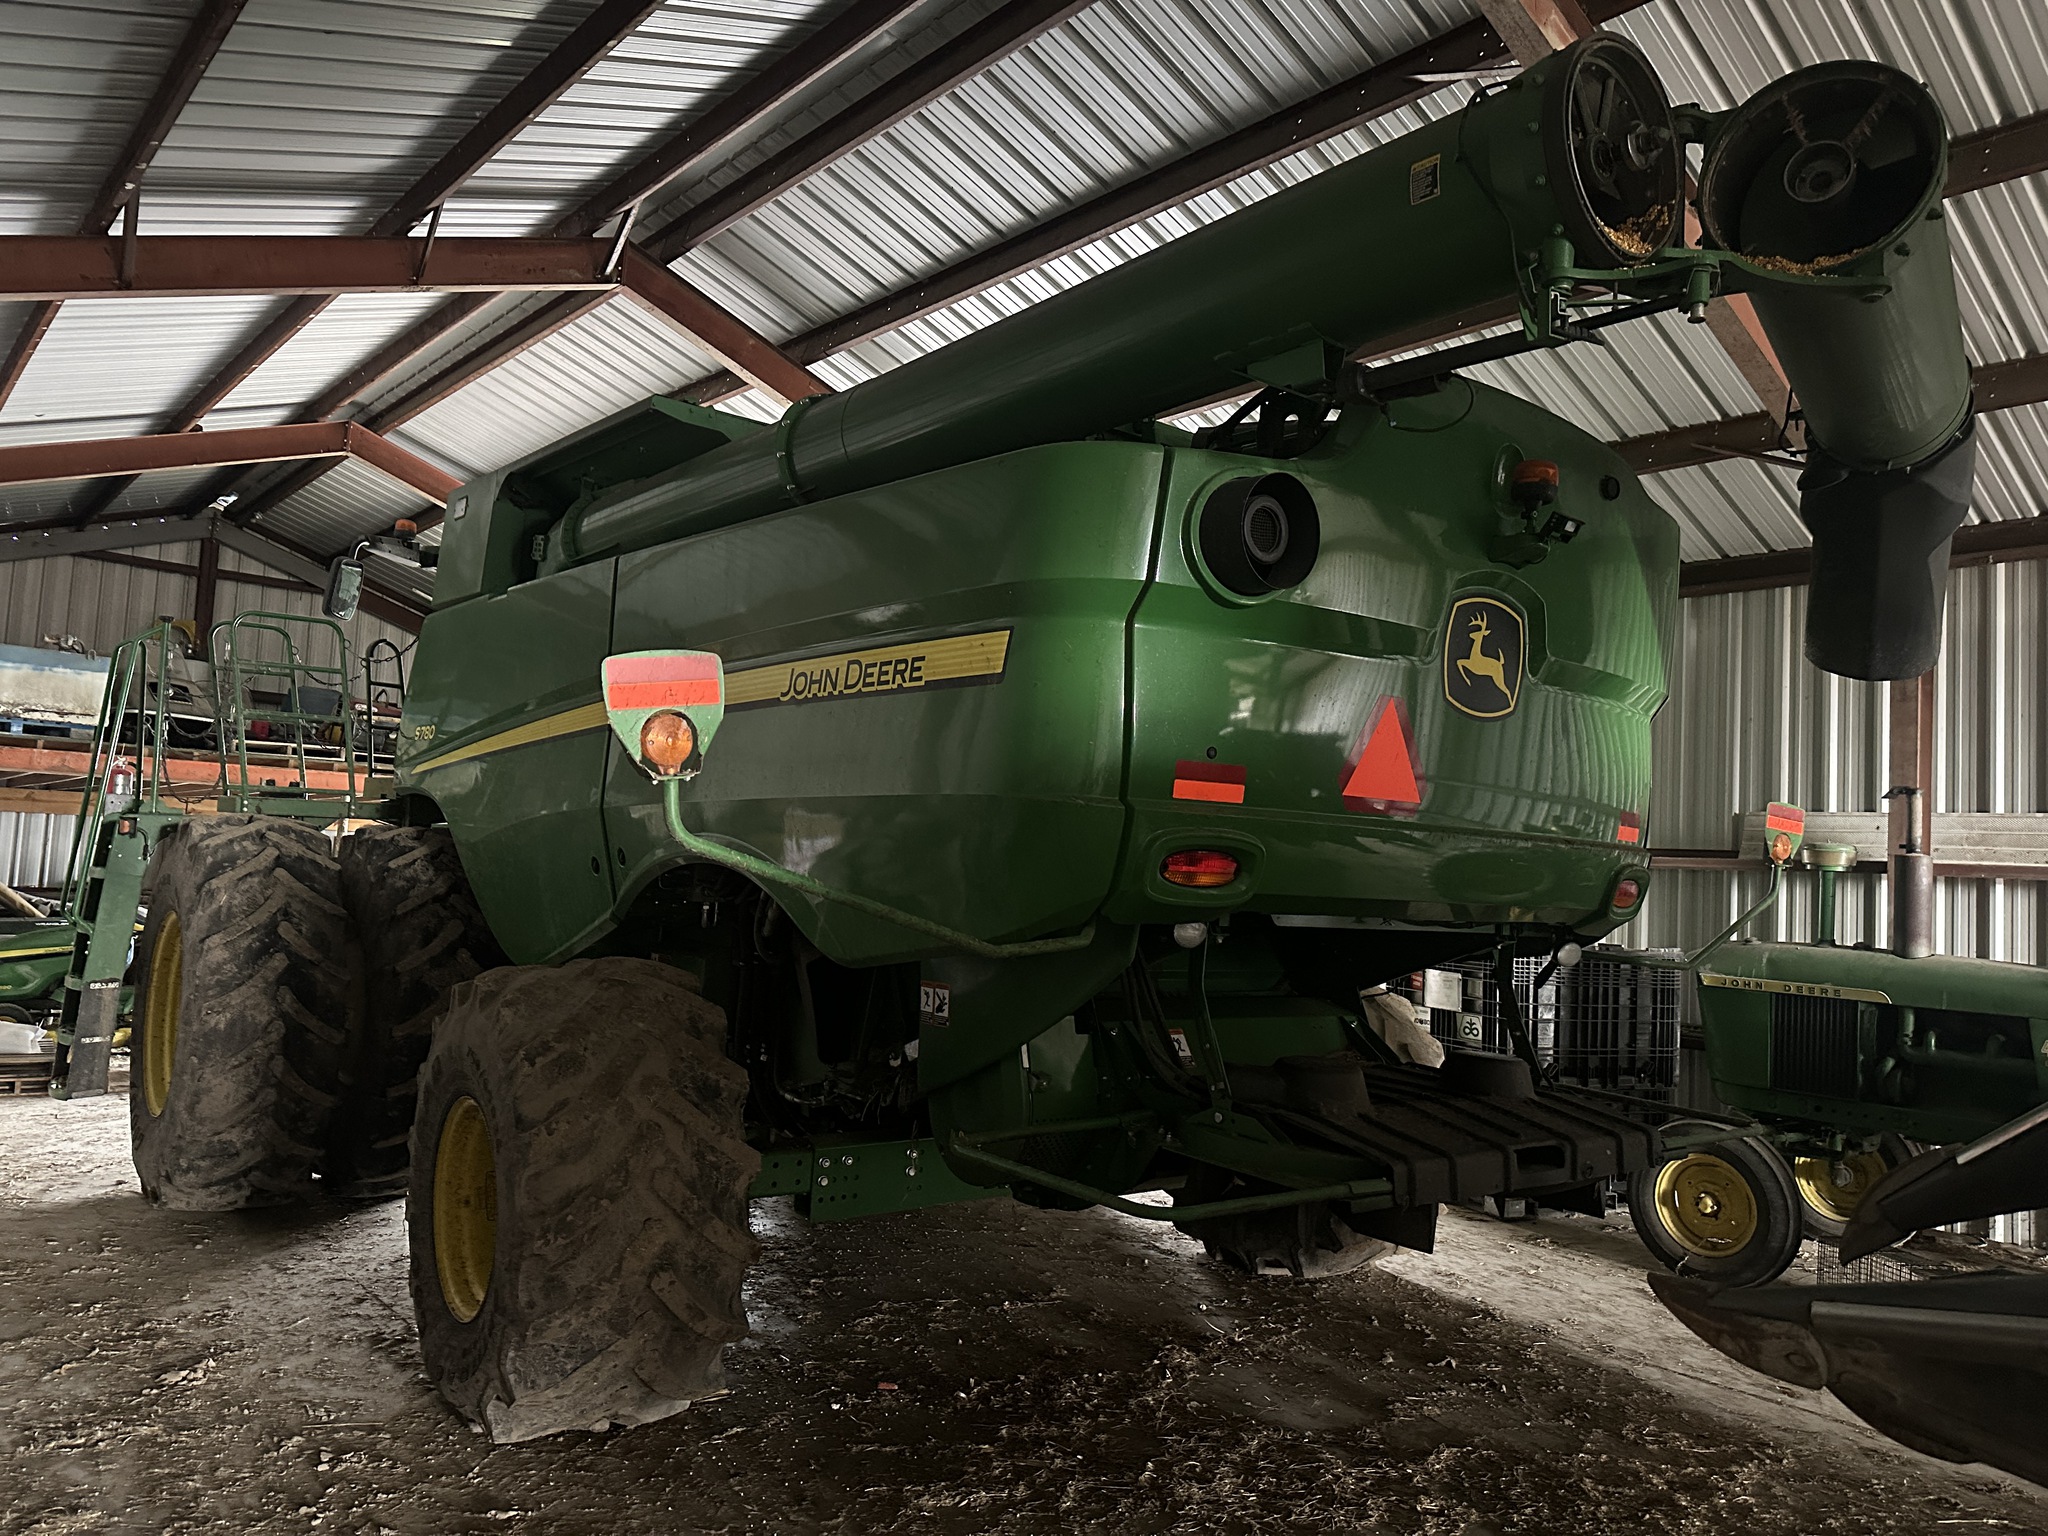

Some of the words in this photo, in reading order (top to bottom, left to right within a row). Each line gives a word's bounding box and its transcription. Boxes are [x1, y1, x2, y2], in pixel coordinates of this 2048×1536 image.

[780, 667, 840, 700] JOHN
[843, 655, 926, 694] DEERE
[415, 724, 436, 740] S780
[1721, 978, 1763, 990] JOHN
[1783, 984, 1842, 998] DEERE
